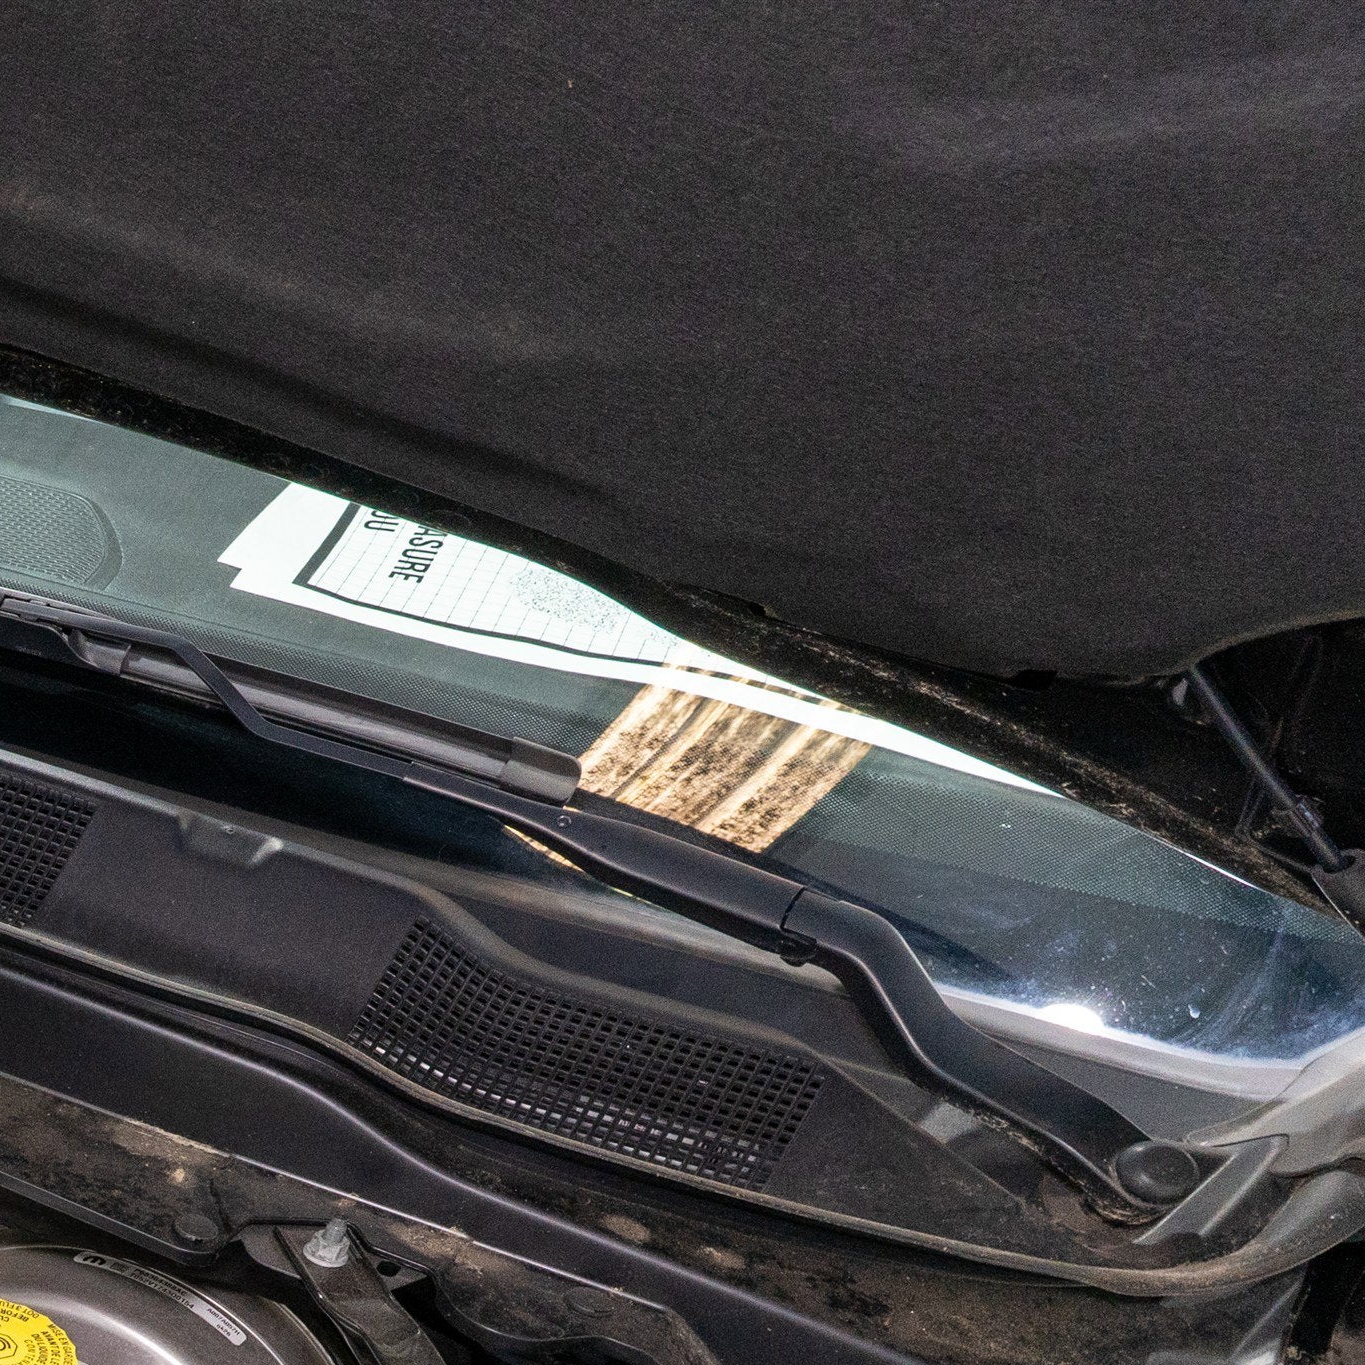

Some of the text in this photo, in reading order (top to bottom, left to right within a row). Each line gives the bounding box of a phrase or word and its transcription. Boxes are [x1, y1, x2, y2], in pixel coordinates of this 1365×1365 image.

[22, 1308, 40, 1319] DOT
[48, 1323, 63, 1336] MISE
[41, 1331, 59, 1350] AVANT
[31, 1334, 40, 1342] DU
[36, 1342, 48, 1364] LIQUIDE
